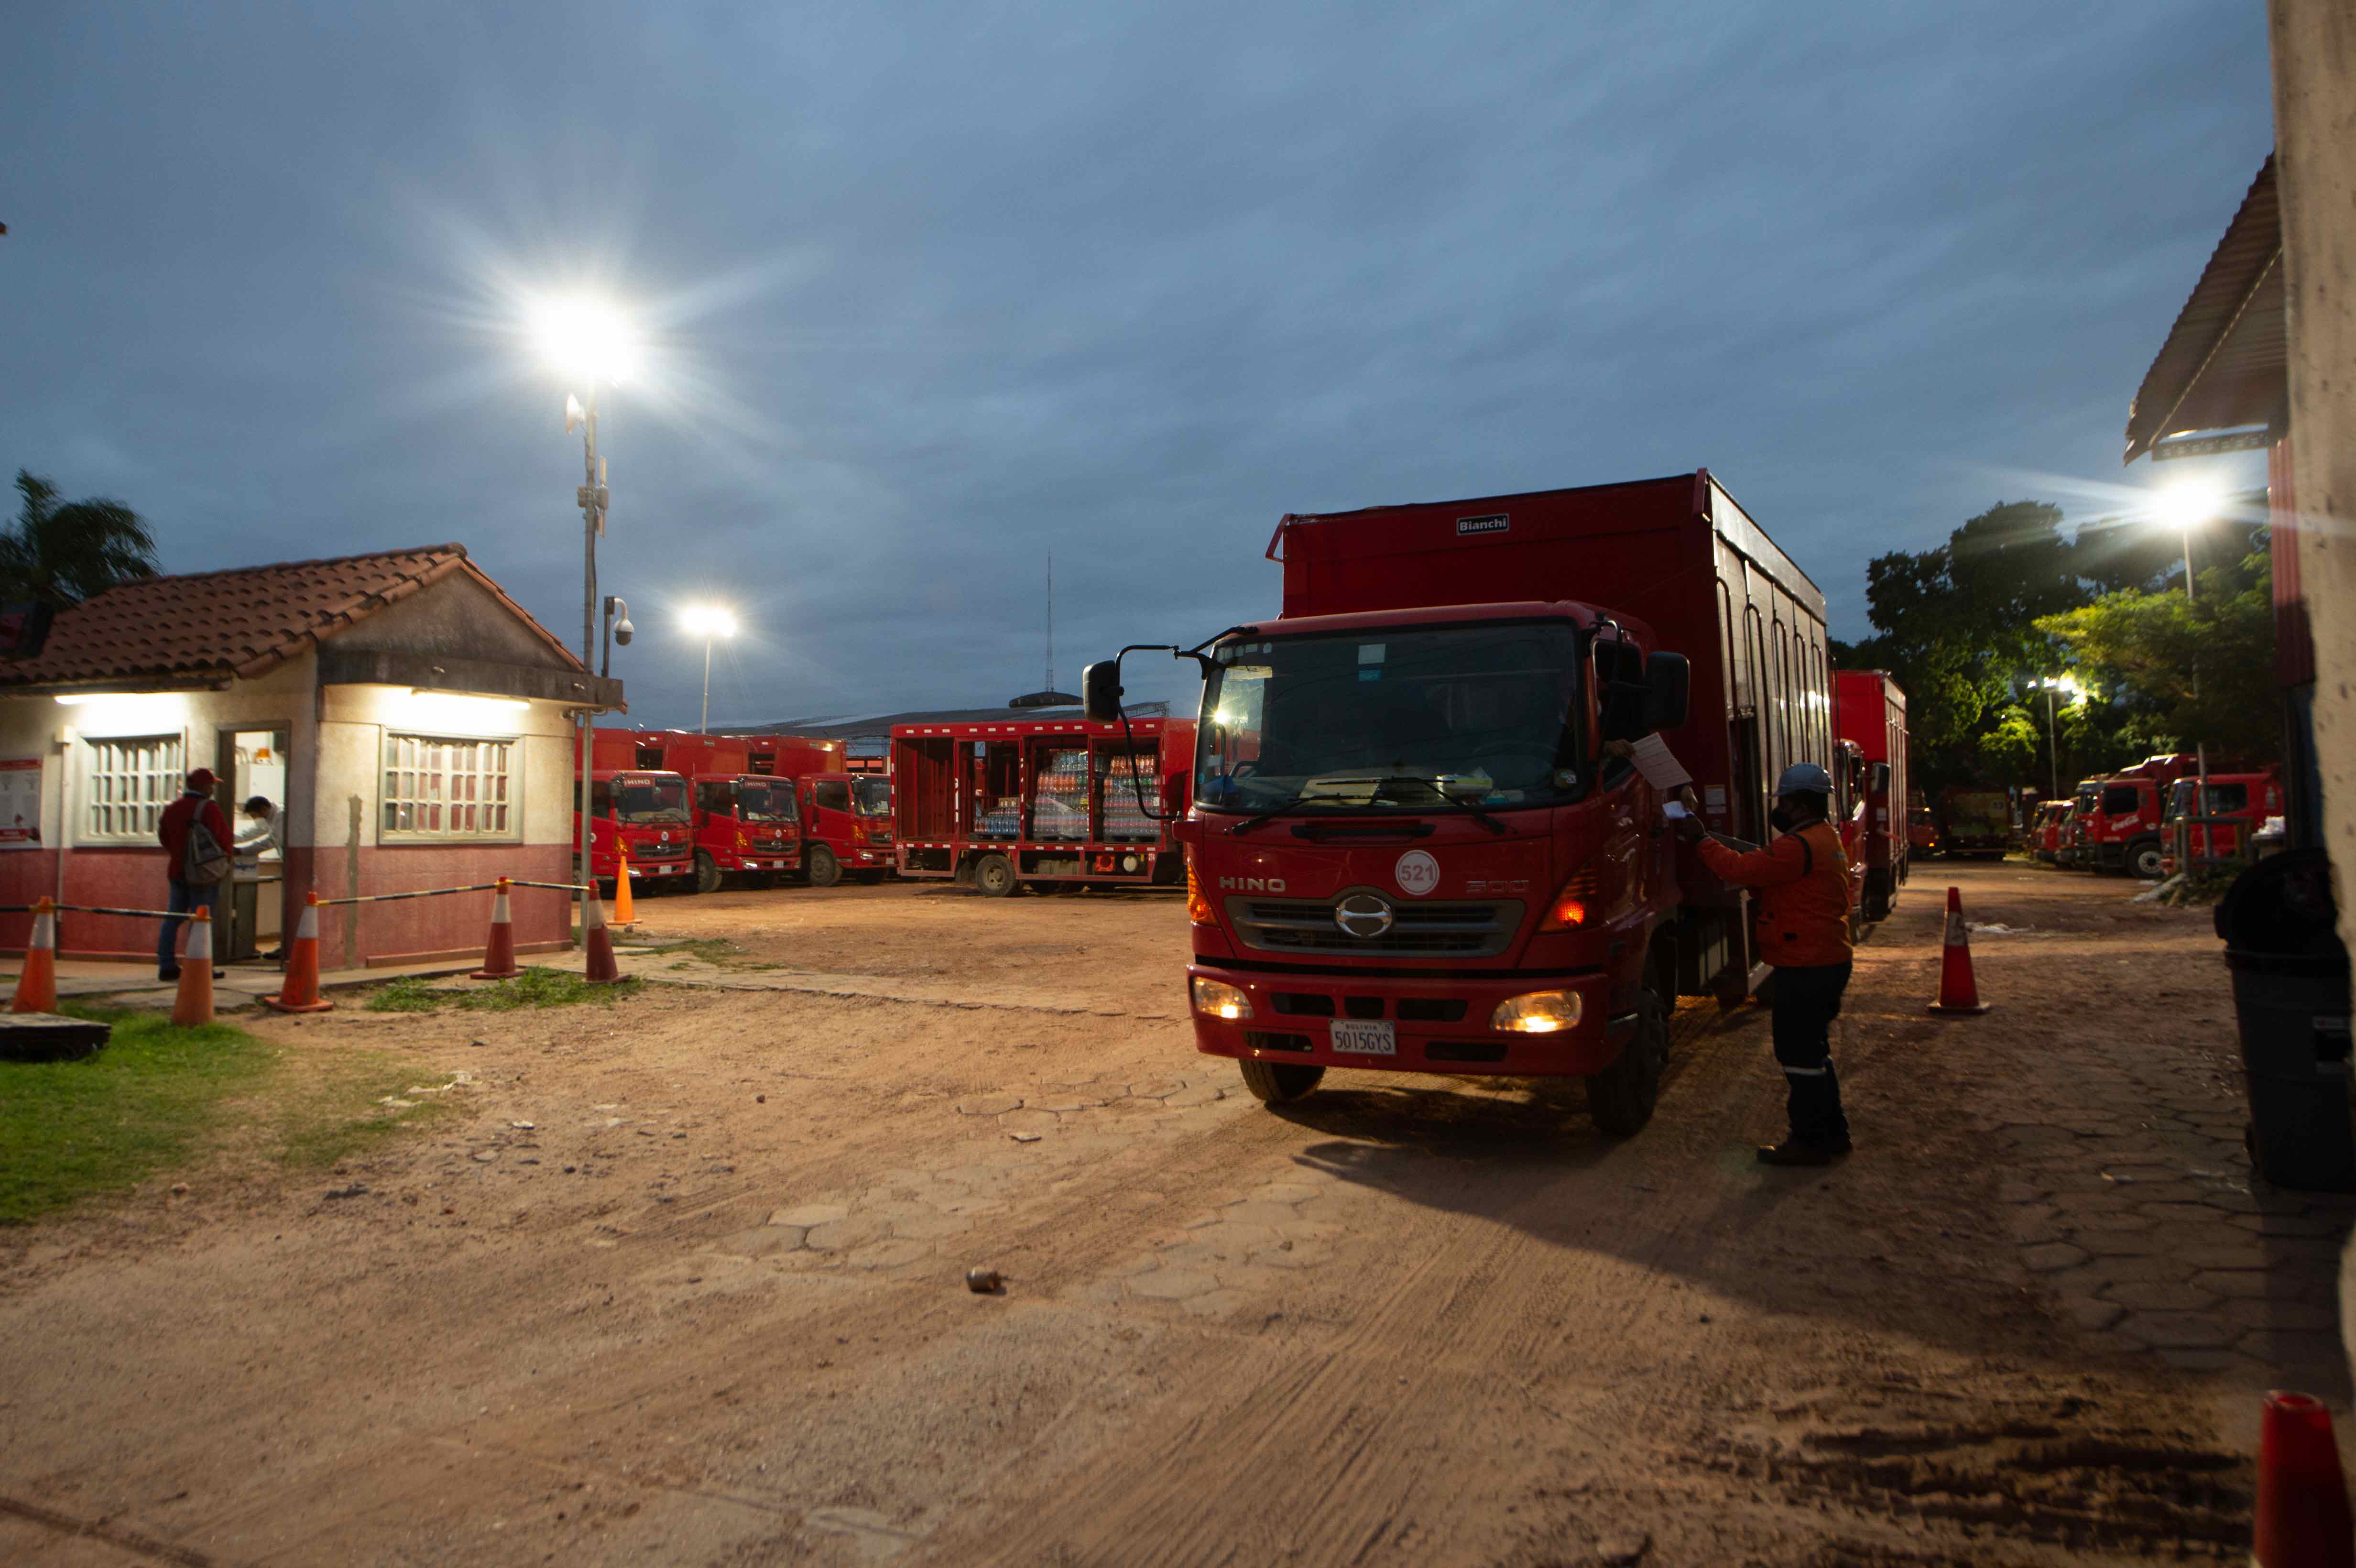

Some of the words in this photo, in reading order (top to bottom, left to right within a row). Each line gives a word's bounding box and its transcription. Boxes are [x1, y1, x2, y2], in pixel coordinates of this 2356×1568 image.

[1460, 518, 1506, 531] Bianchi
[1401, 864, 1434, 881] 521
[1220, 876, 1286, 892] HINO
[1465, 880, 1530, 894] 500
[1335, 1031, 1391, 1051] 5015GYS
